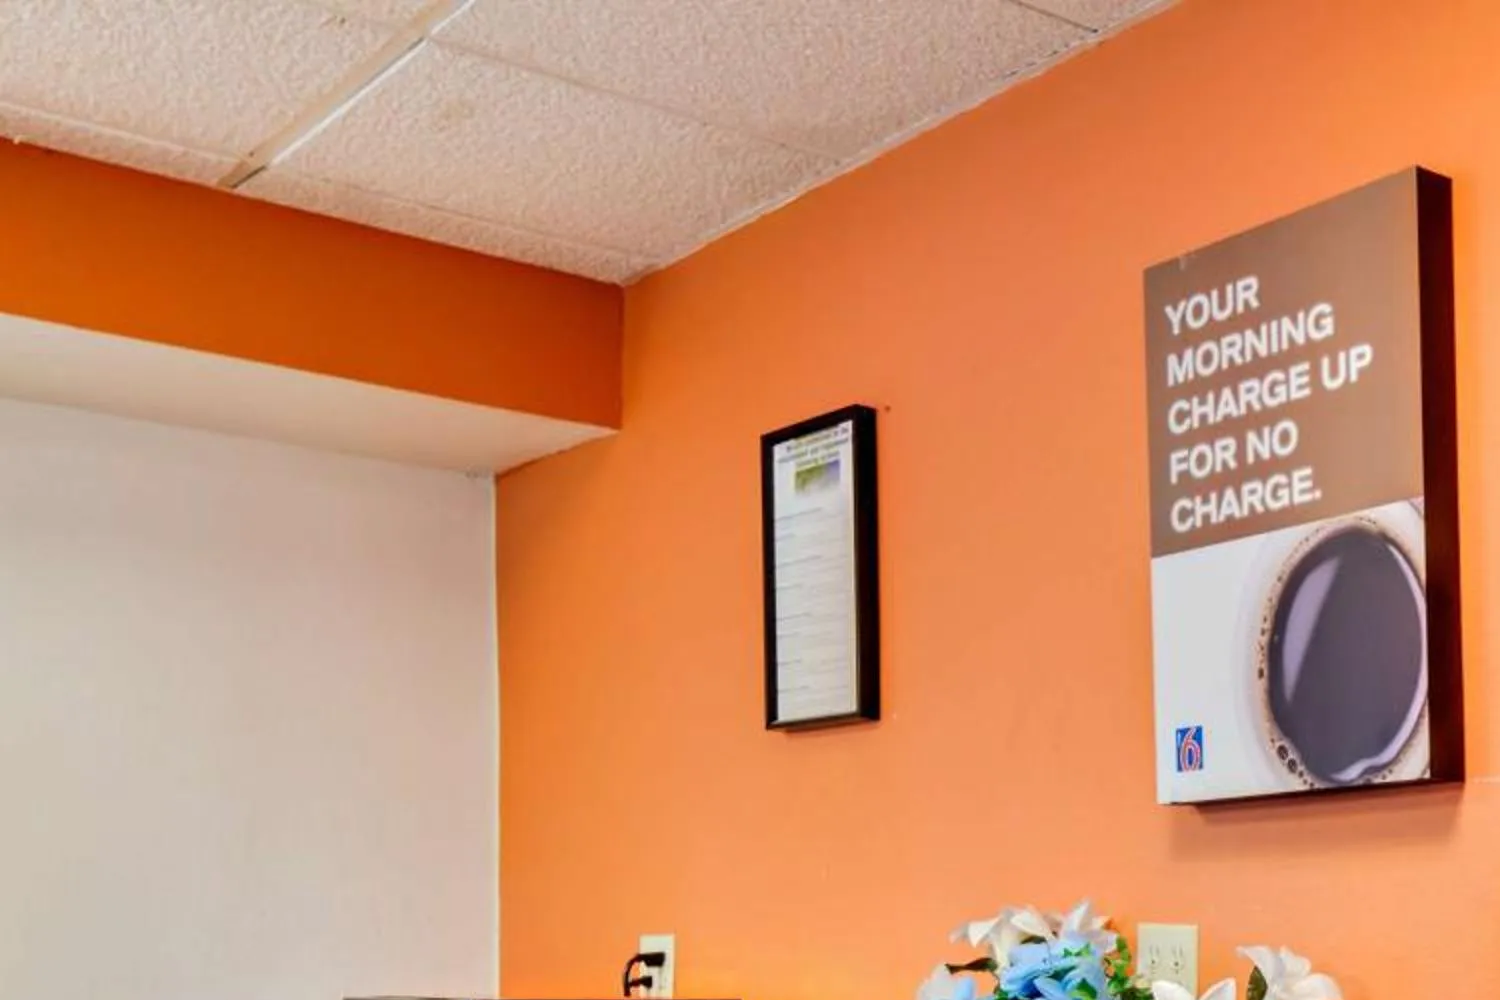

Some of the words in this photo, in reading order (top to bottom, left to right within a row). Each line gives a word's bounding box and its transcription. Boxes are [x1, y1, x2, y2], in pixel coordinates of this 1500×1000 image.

[1164, 275, 1260, 336] YOUR
[1166, 303, 1335, 387] MORNING
[1167, 362, 1312, 435] CHARGE
[1320, 344, 1373, 390] UP
[1169, 437, 1238, 484] FOR
[1245, 419, 1298, 464] NO
[1170, 467, 1322, 533] CHARGE.
